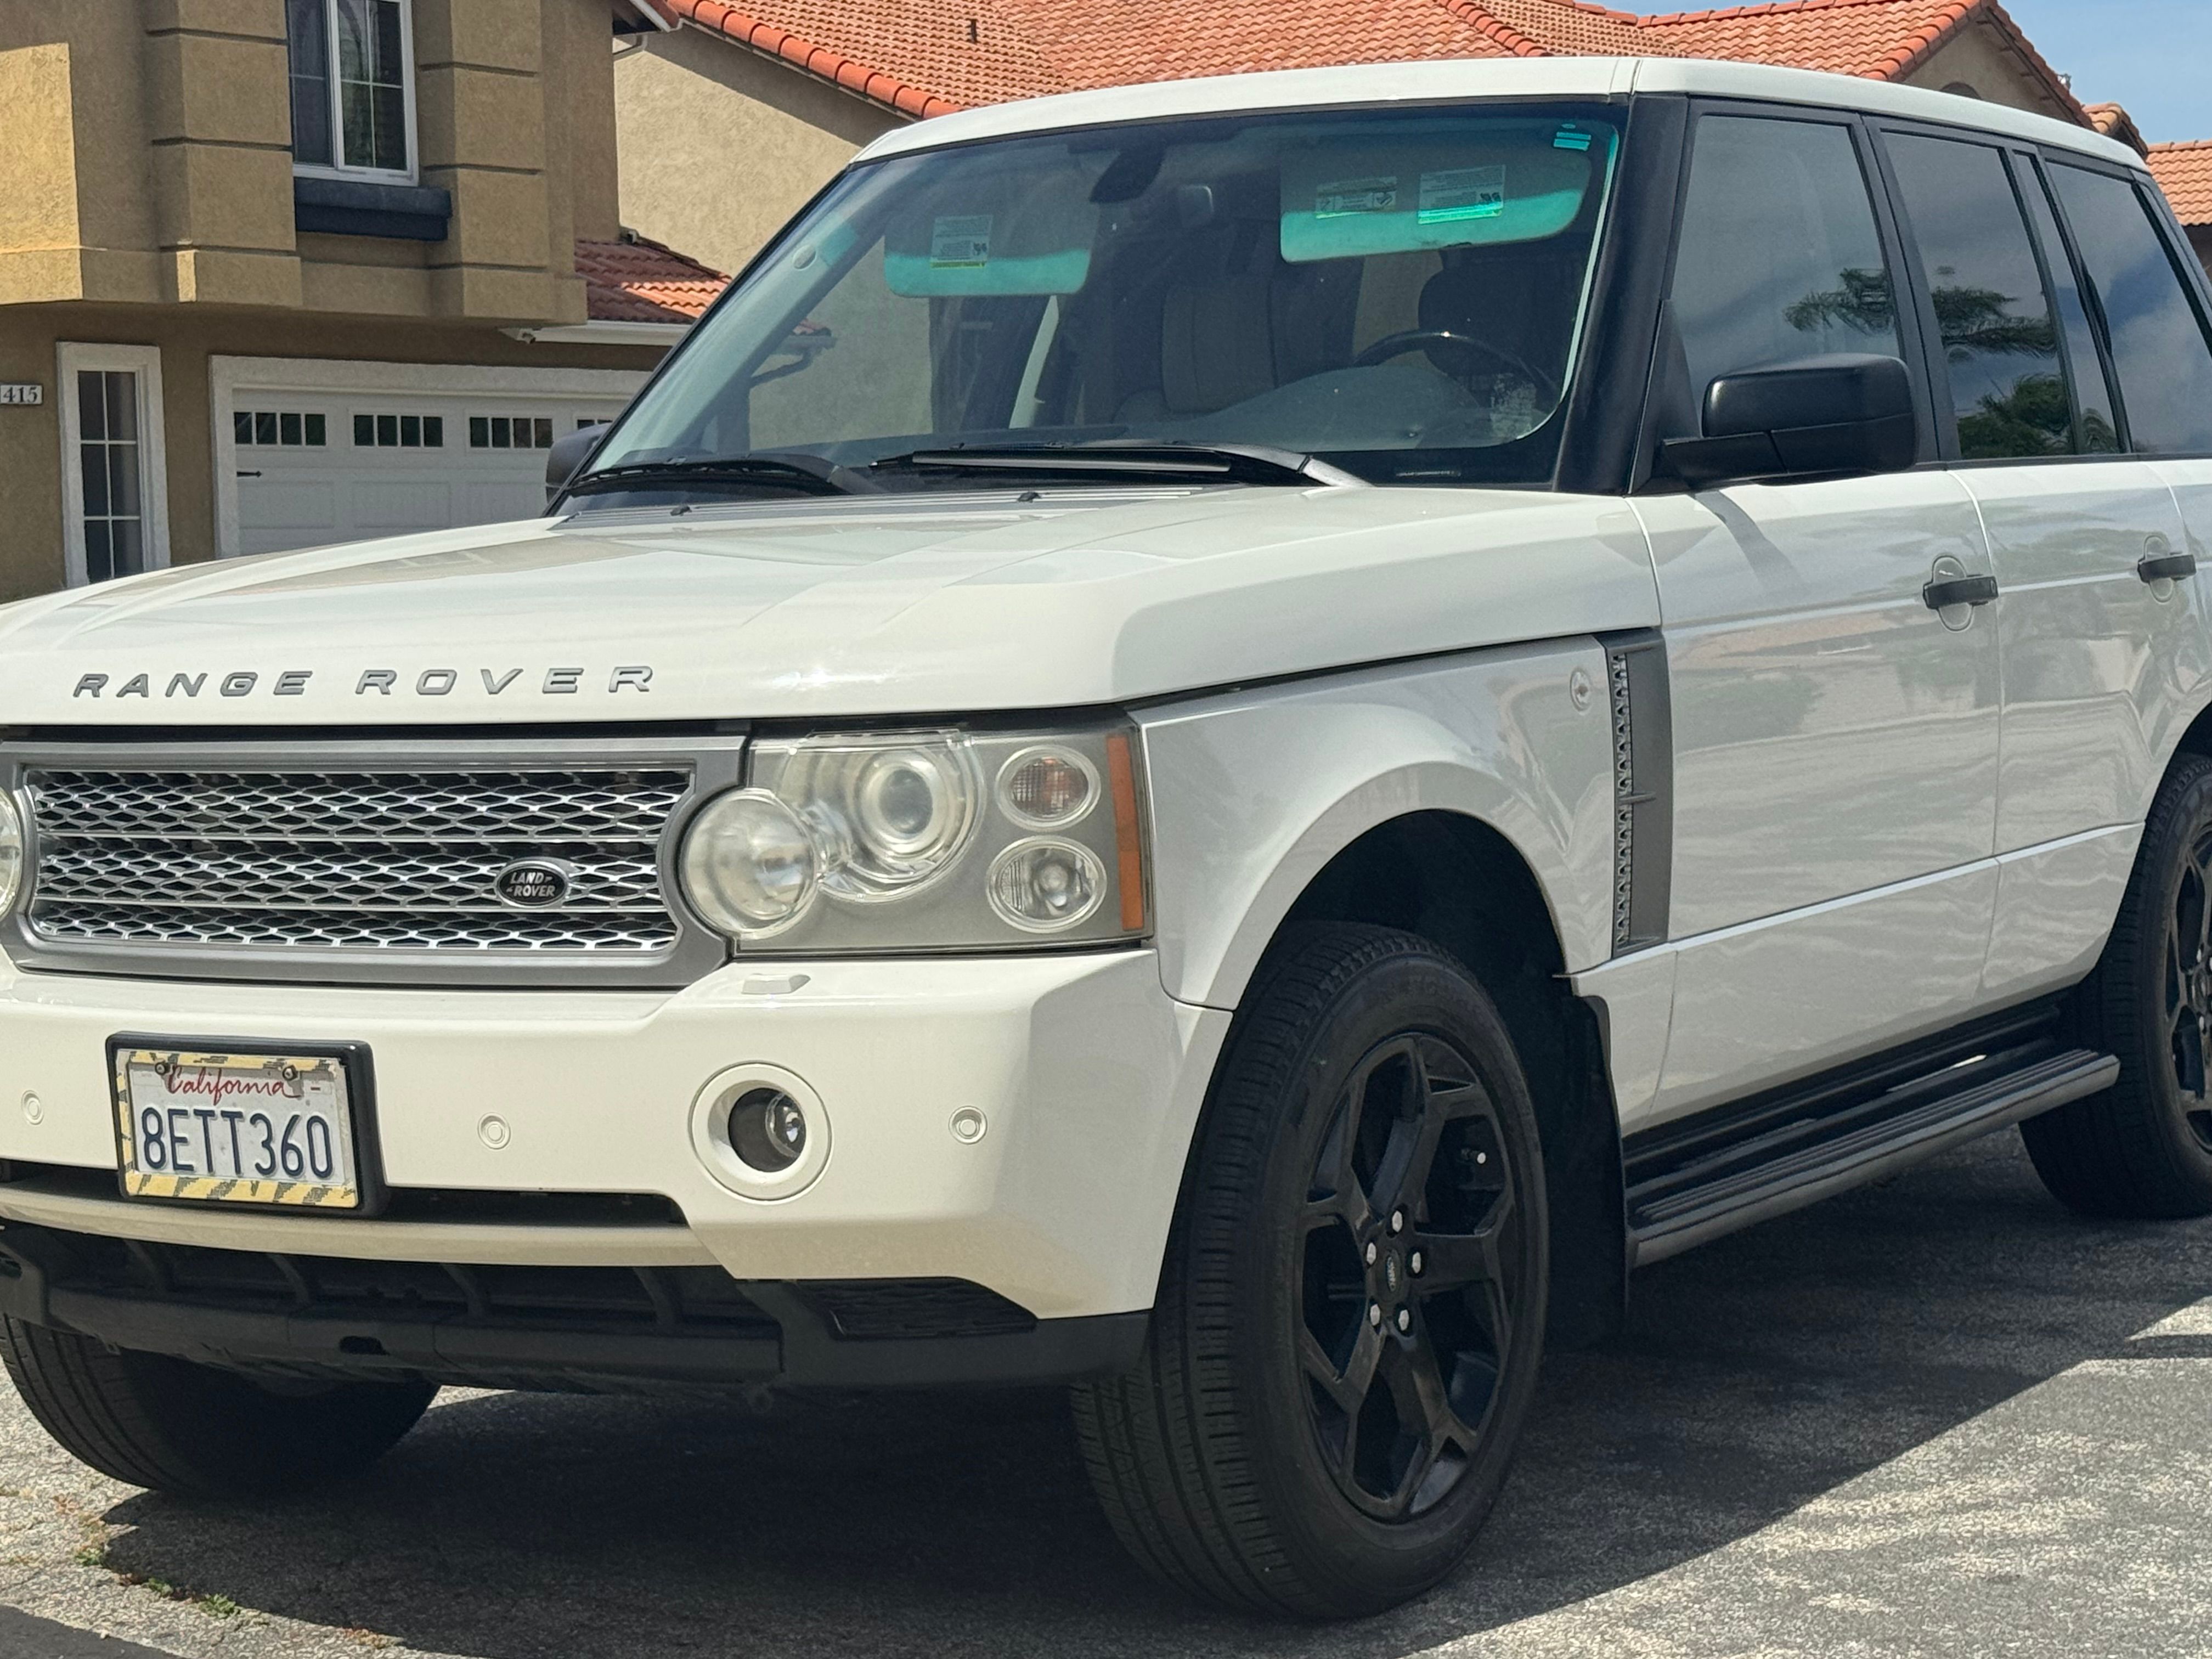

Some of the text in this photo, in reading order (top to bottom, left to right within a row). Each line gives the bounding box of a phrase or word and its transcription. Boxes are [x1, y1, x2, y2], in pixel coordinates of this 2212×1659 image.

[73, 665, 653, 697] RANGE ROVER
[510, 872, 544, 884] LAND
[514, 884, 556, 897] ROVER
[167, 1065, 303, 1106] California
[142, 1107, 333, 1178] 8ETT360
